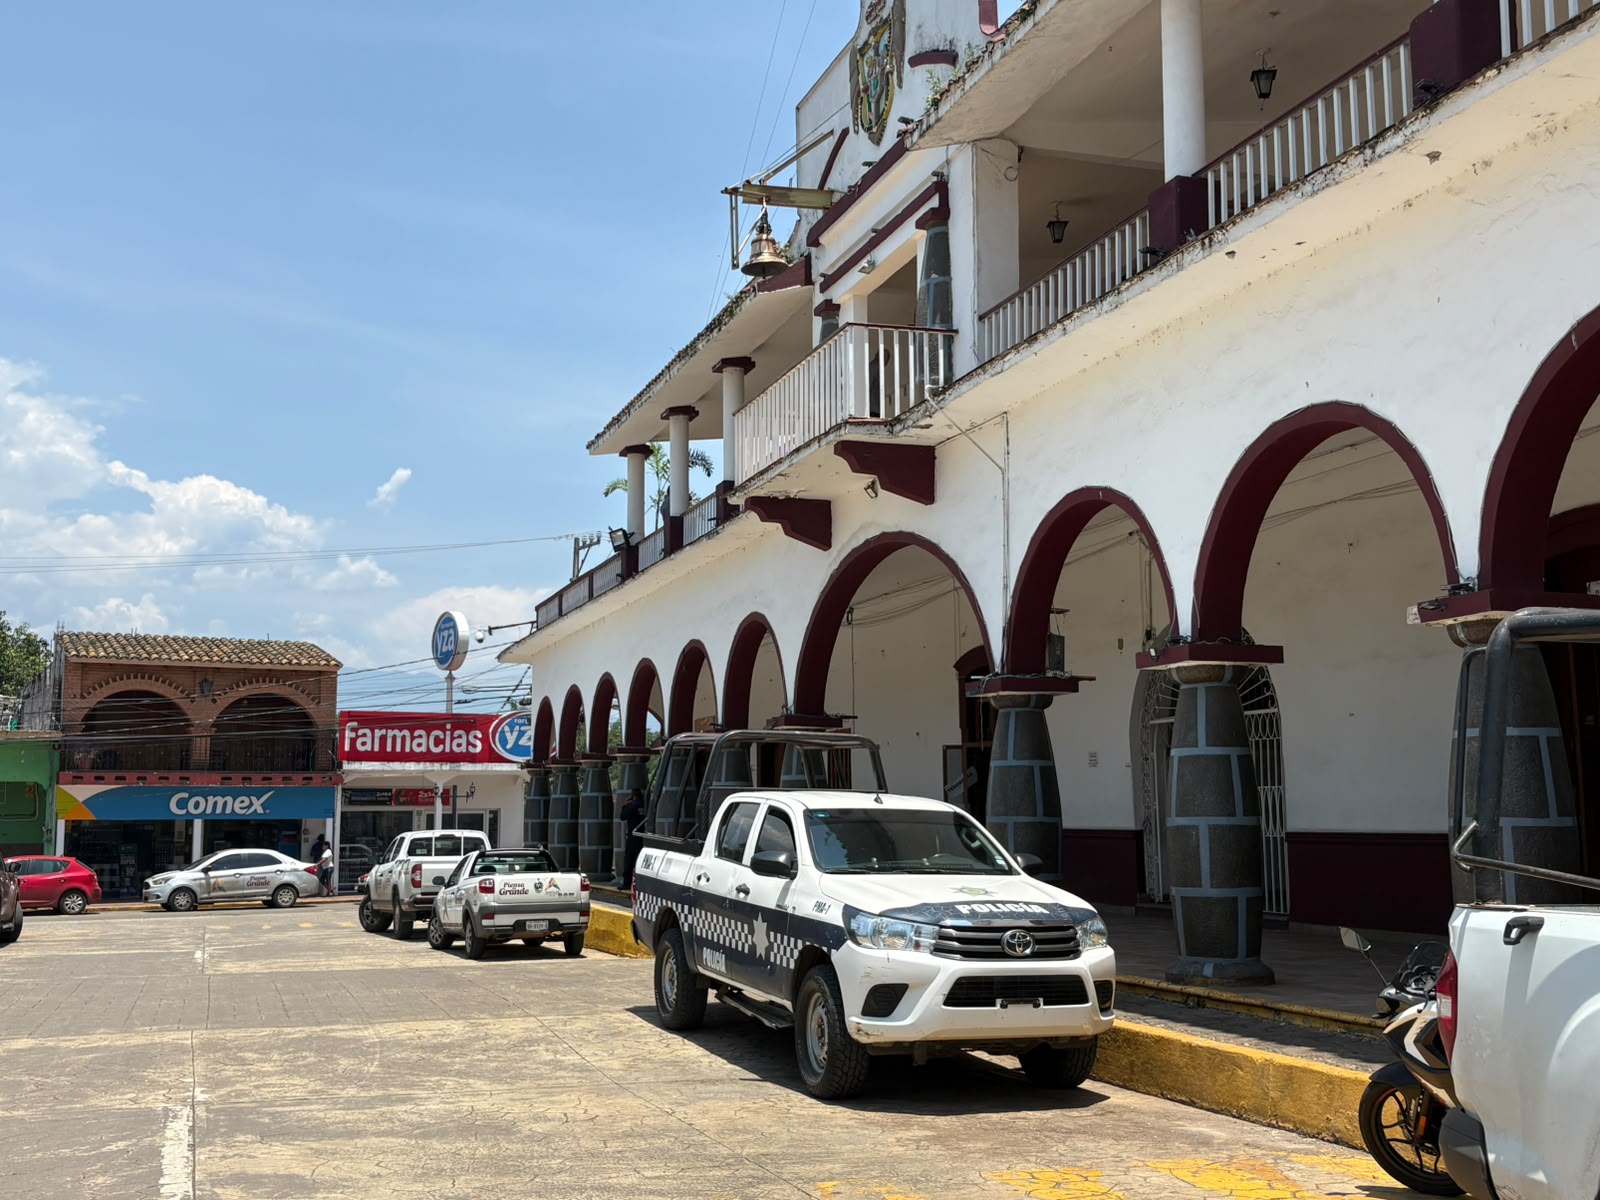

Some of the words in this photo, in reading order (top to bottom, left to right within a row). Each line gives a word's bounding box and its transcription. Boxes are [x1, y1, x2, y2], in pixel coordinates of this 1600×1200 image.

[169, 790, 275, 815] Comex
[499, 887, 529, 896] Grande
[954, 903, 1050, 914] POLICÍA
[702, 946, 727, 974] POLICÍA
